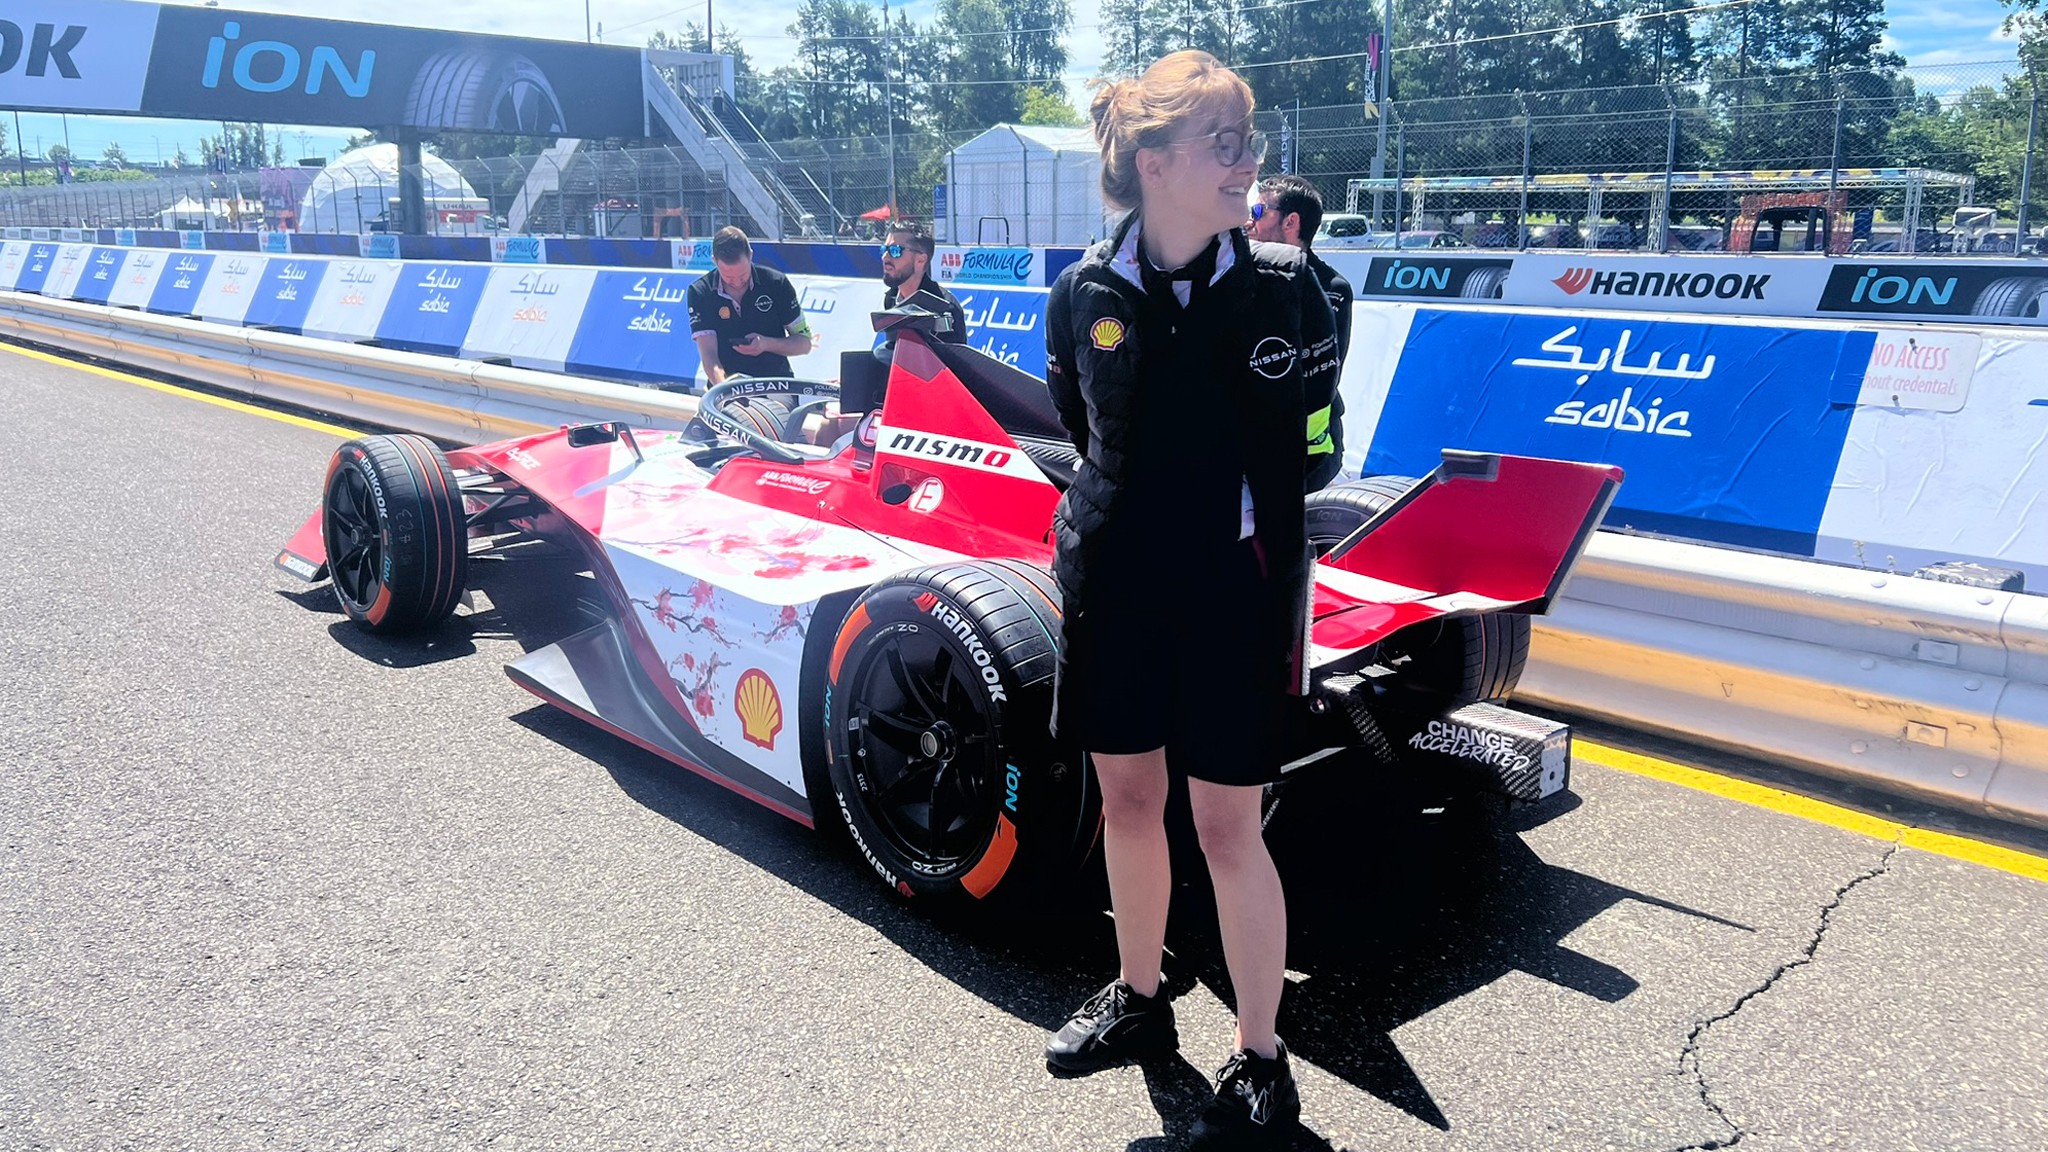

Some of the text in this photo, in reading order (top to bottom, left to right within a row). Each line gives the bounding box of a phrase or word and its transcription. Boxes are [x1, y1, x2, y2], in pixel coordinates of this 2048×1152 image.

[941, 253, 961, 267] ABB
[962, 252, 1014, 271] FORMULA
[622, 276, 685, 309] سابك
[627, 307, 673, 333] sabic
[1249, 347, 1297, 369] NISSAN
[1512, 325, 1716, 389] سابك
[1894, 345, 1949, 372] ACCESS
[731, 381, 789, 396] NISSAN
[1893, 376, 1957, 396] credentials
[1544, 387, 1693, 437] sabic
[703, 412, 751, 445] NISSAN
[1427, 720, 1515, 754] CHANGE
